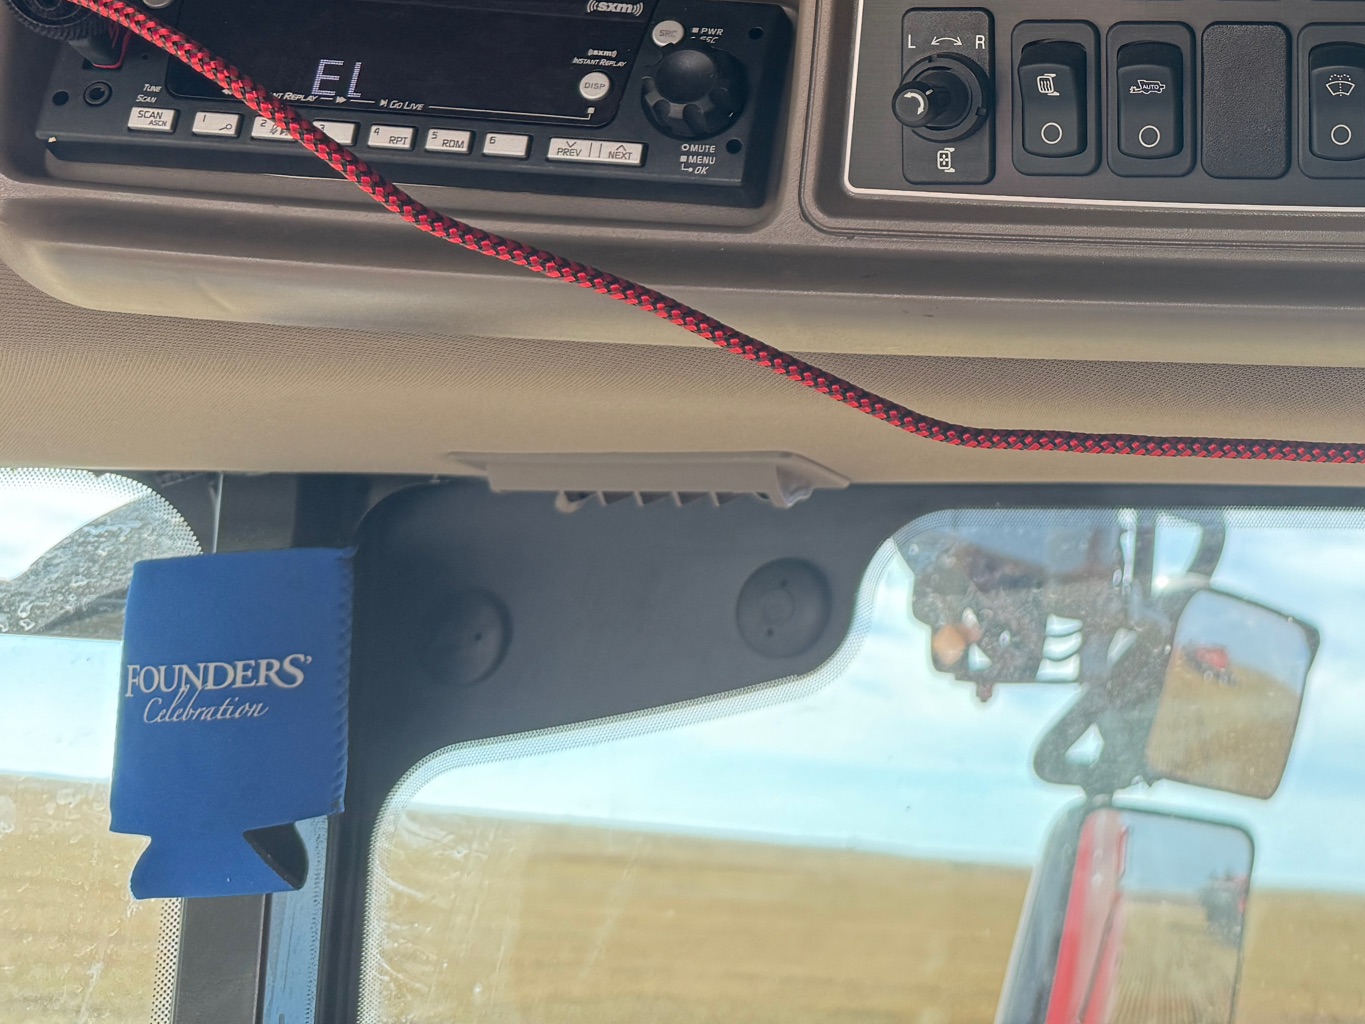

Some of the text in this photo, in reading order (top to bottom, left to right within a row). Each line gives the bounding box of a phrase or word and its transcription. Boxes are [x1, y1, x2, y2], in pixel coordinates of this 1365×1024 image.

[658, 29, 678, 38] SRC
[701, 27, 724, 36] PWR
[907, 34, 917, 49] L
[975, 34, 986, 50] R
[572, 56, 628, 67] INSTANT REPLAY
[142, 83, 163, 93] TUNE
[135, 94, 158, 104] SCAN
[282, 91, 319, 103] REPLAY
[137, 109, 163, 120] SCAN
[260, 119, 268, 128] 2
[373, 127, 380, 136] 4
[431, 131, 439, 140] 5
[388, 135, 409, 146] RPT
[441, 138, 465, 149] RDM
[489, 136, 497, 145] 6
[556, 148, 583, 157] PREV
[689, 144, 716, 153] MUTE
[608, 151, 633, 160] NEXT
[687, 155, 716, 165] MENU
[694, 166, 709, 175] OK
[143, 684, 270, 724] Celebration
